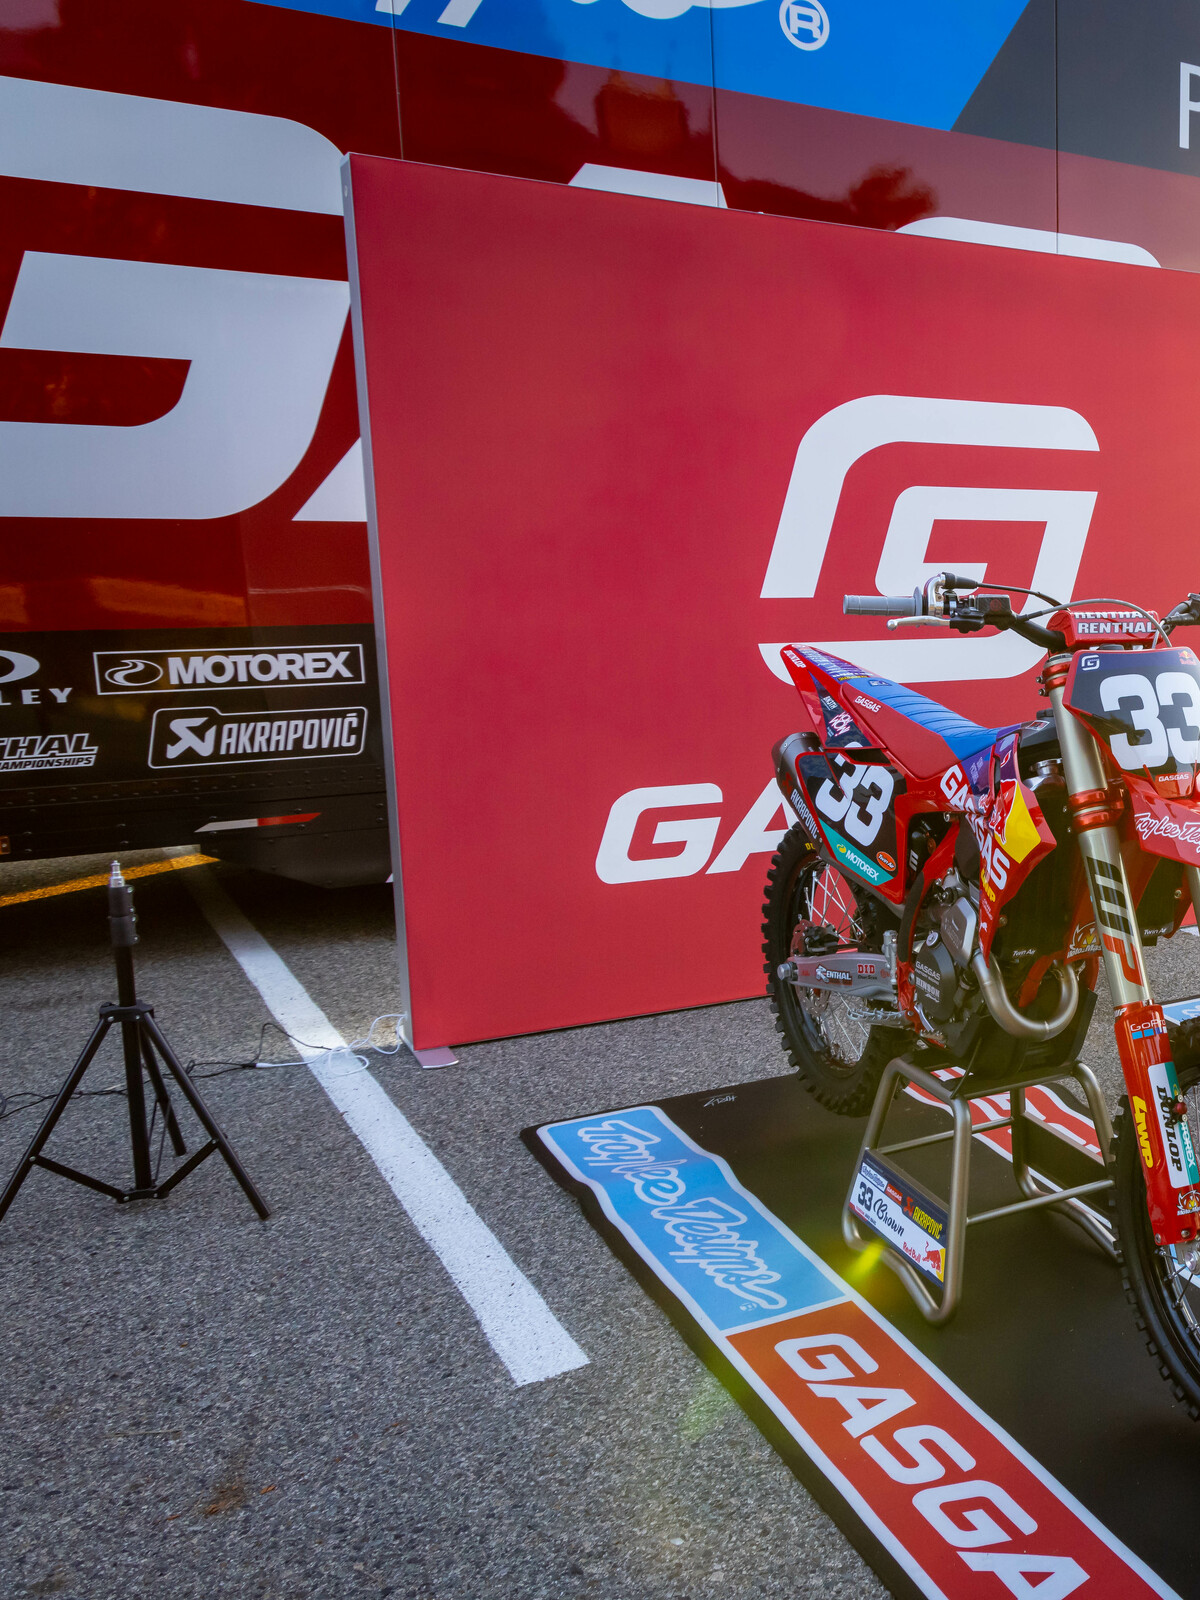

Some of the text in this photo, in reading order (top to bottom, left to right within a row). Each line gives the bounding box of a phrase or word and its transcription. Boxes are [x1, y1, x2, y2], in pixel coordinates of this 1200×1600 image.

[1078, 621, 1157, 634] RENTHAL
[168, 651, 354, 685] MOTOREX
[855, 695, 882, 713] GASGAS
[0, 757, 93, 771] AMPIONSHIPS
[1158, 773, 1190, 783] GASGAS
[815, 742, 895, 847] 33
[1134, 813, 1157, 840] Troy
[1155, 816, 1179, 836] Lee
[845, 849, 880, 881] MOTOREX
[857, 964, 875, 974] DID
[916, 961, 940, 980] GASGAS
[1156, 1085, 1183, 1172] DUNLOP
[578, 1120, 662, 1167] Troy
[611, 1158, 688, 1206] Lee
[858, 1181, 905, 1237] 33 Brown
[651, 1197, 788, 1310] Designs
[902, 1241, 921, 1264] Red Bull
